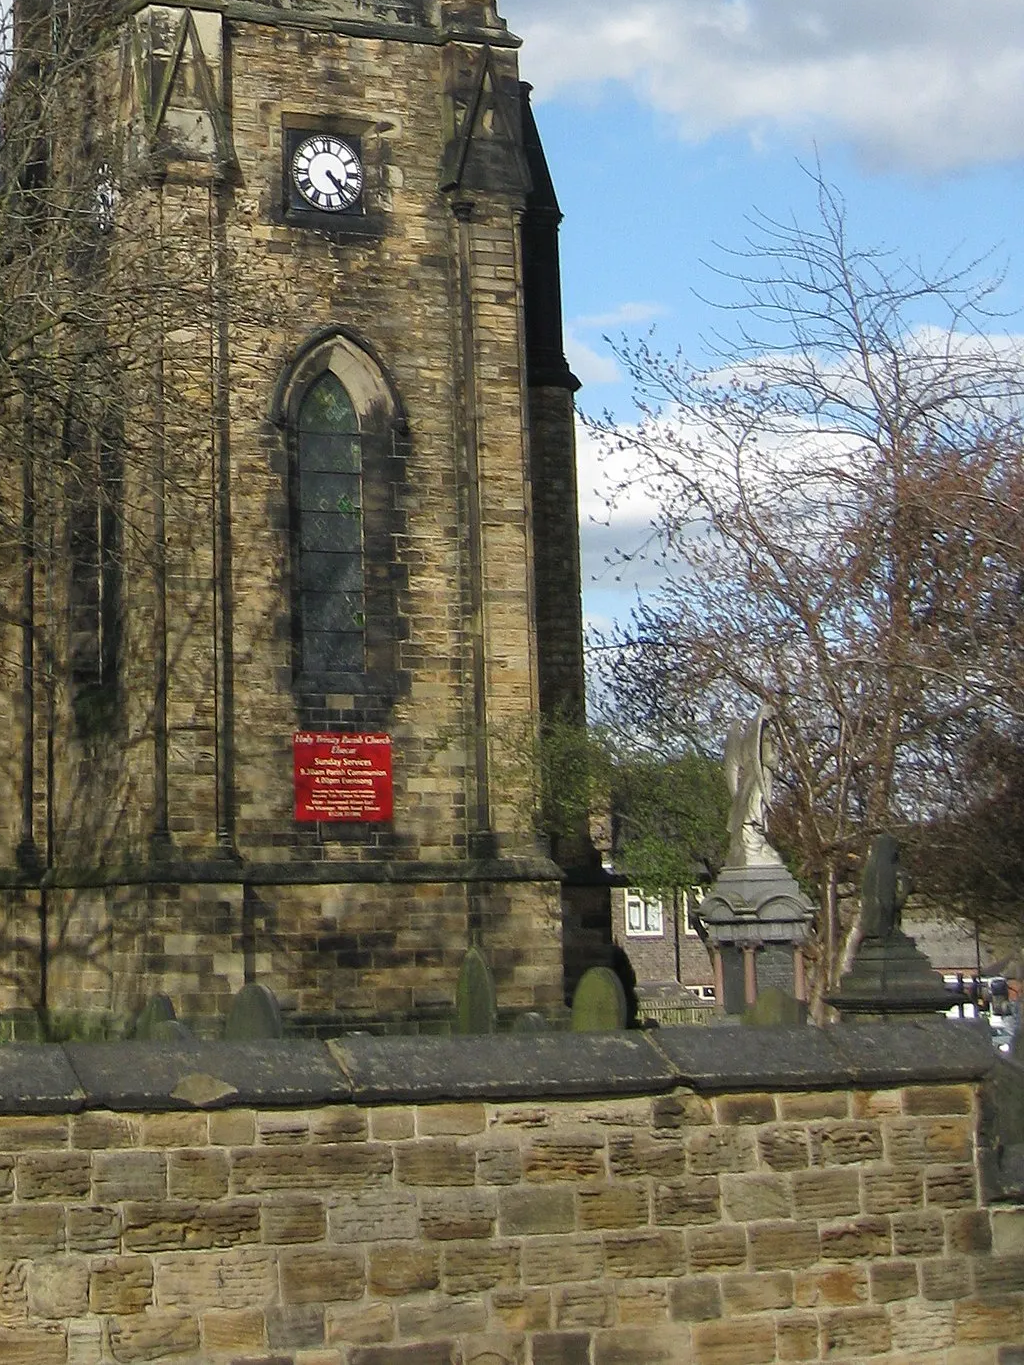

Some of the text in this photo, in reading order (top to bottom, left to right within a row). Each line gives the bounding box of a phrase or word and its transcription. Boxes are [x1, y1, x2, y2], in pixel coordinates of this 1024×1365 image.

[295, 734, 313, 745] Holy
[316, 735, 340, 744] Trinity
[341, 735, 363, 744] Parish
[314, 757, 372, 767] Sunday Services
[326, 768, 346, 776] Parish
[347, 768, 387, 777] Communion
[342, 777, 373, 786] Evensong
